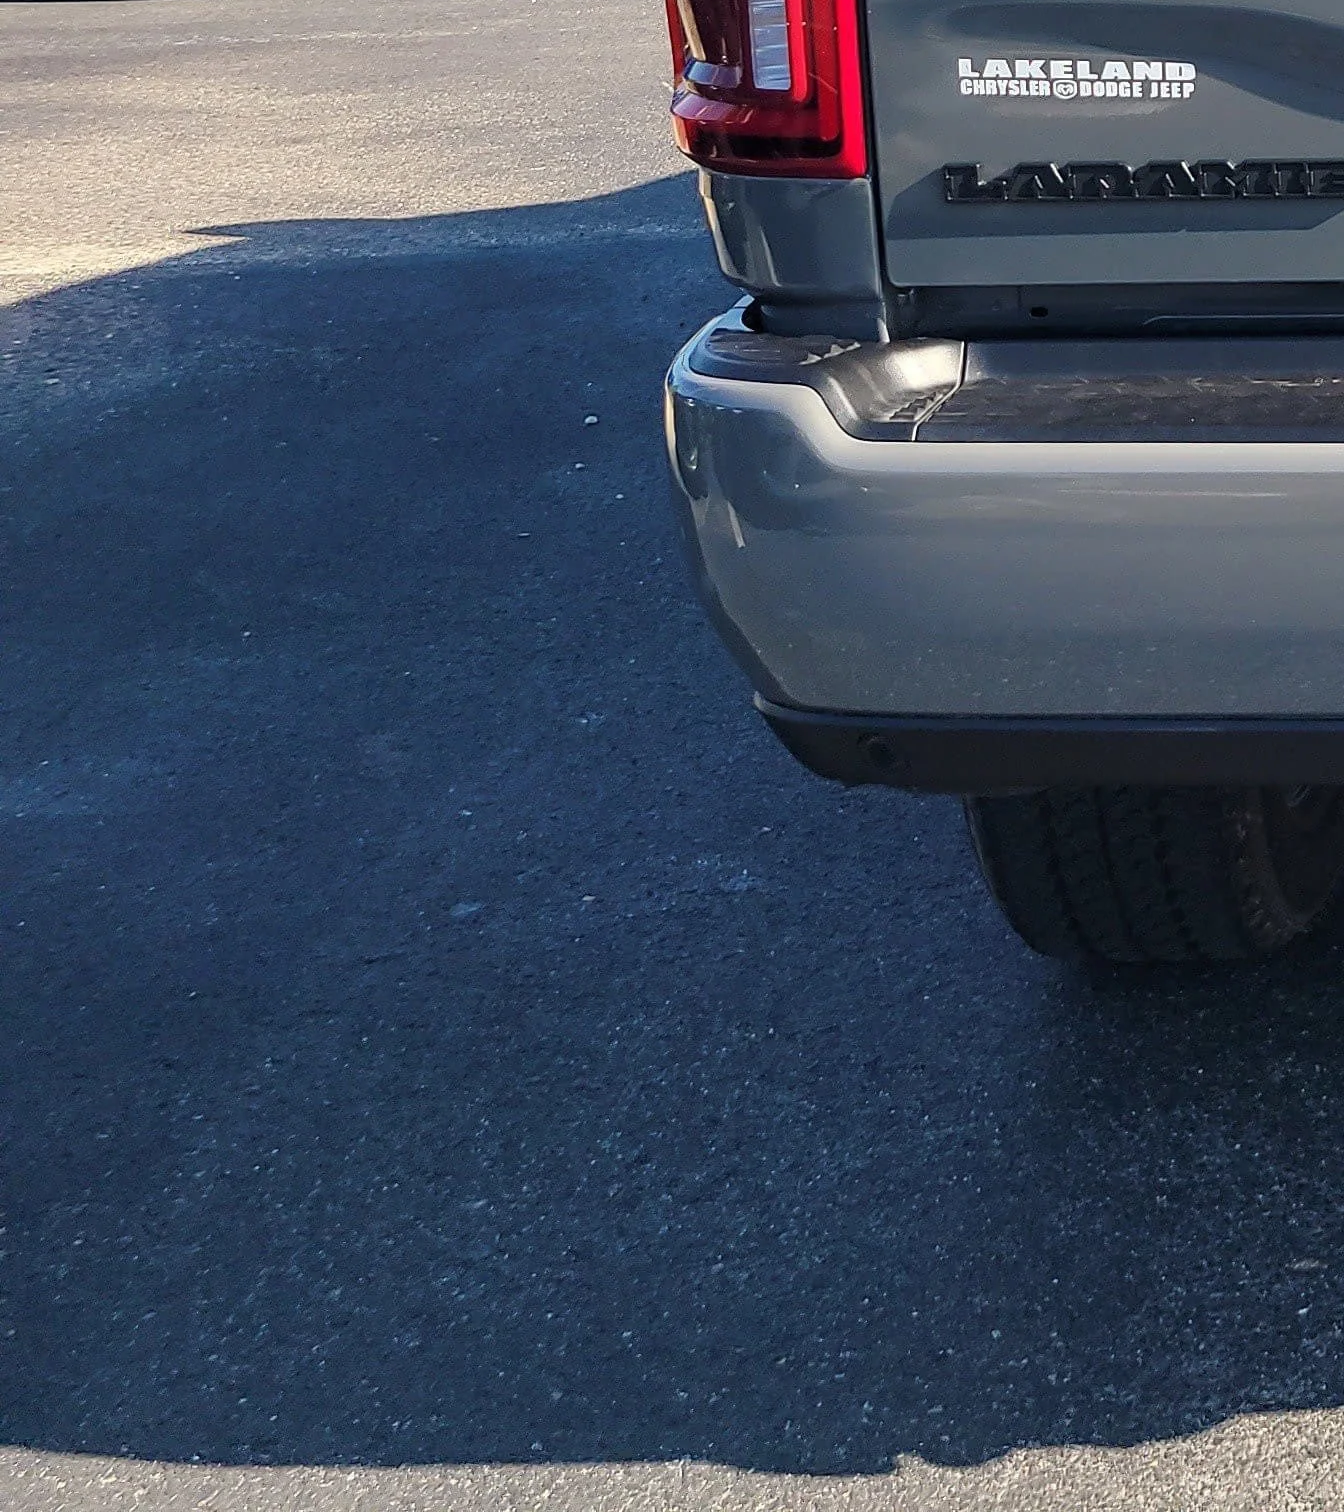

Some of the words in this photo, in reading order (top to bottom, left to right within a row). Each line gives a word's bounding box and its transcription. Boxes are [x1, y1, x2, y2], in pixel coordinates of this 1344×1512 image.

[957, 57, 1197, 81] LAKELAND
[959, 78, 1052, 97] CHRYSLER
[1079, 80, 1144, 98] DODGE
[1149, 81, 1196, 99] JEEP
